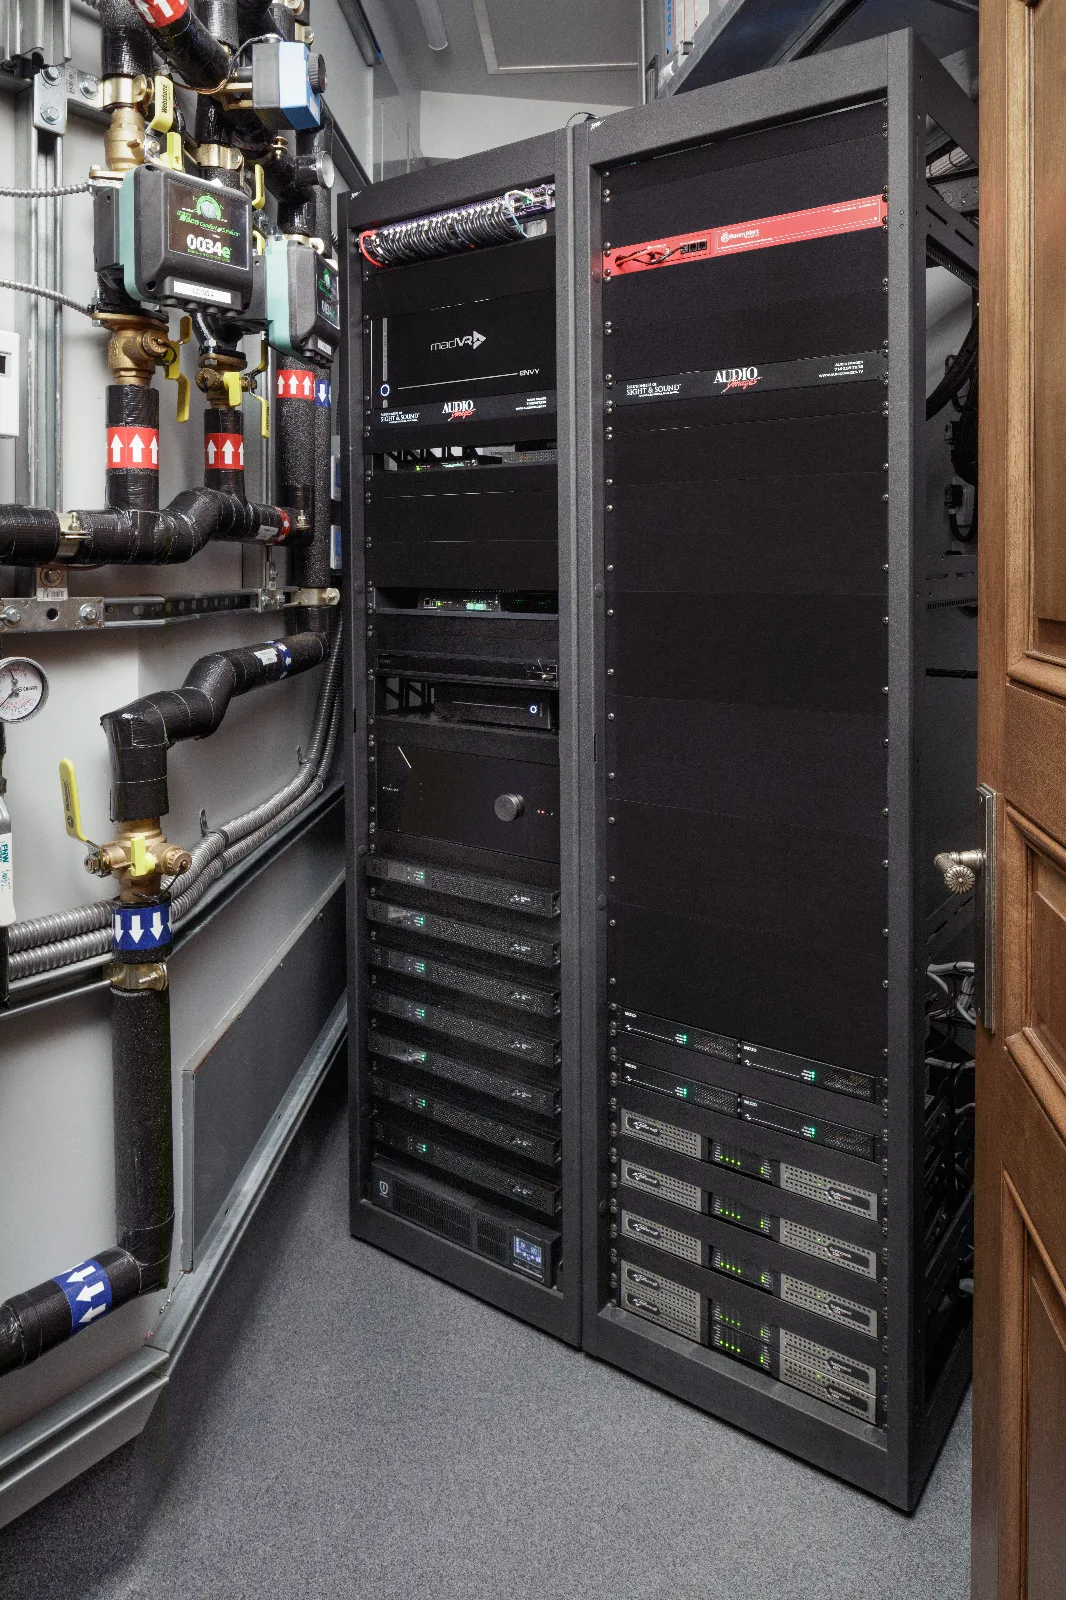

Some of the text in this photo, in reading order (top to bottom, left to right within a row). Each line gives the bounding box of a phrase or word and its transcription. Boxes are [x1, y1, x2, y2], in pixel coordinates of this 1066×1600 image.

[430, 335, 473, 351] madVR
[519, 368, 540, 377] ENVY
[713, 367, 758, 384] AUDIO
[626, 387, 647, 396] SIGHT
[647, 387, 654, 395] &
[654, 384, 680, 393] SOUND
[441, 399, 474, 414] AUDIO
[380, 415, 395, 423] SIGHT
[400, 413, 418, 421] SOUND
